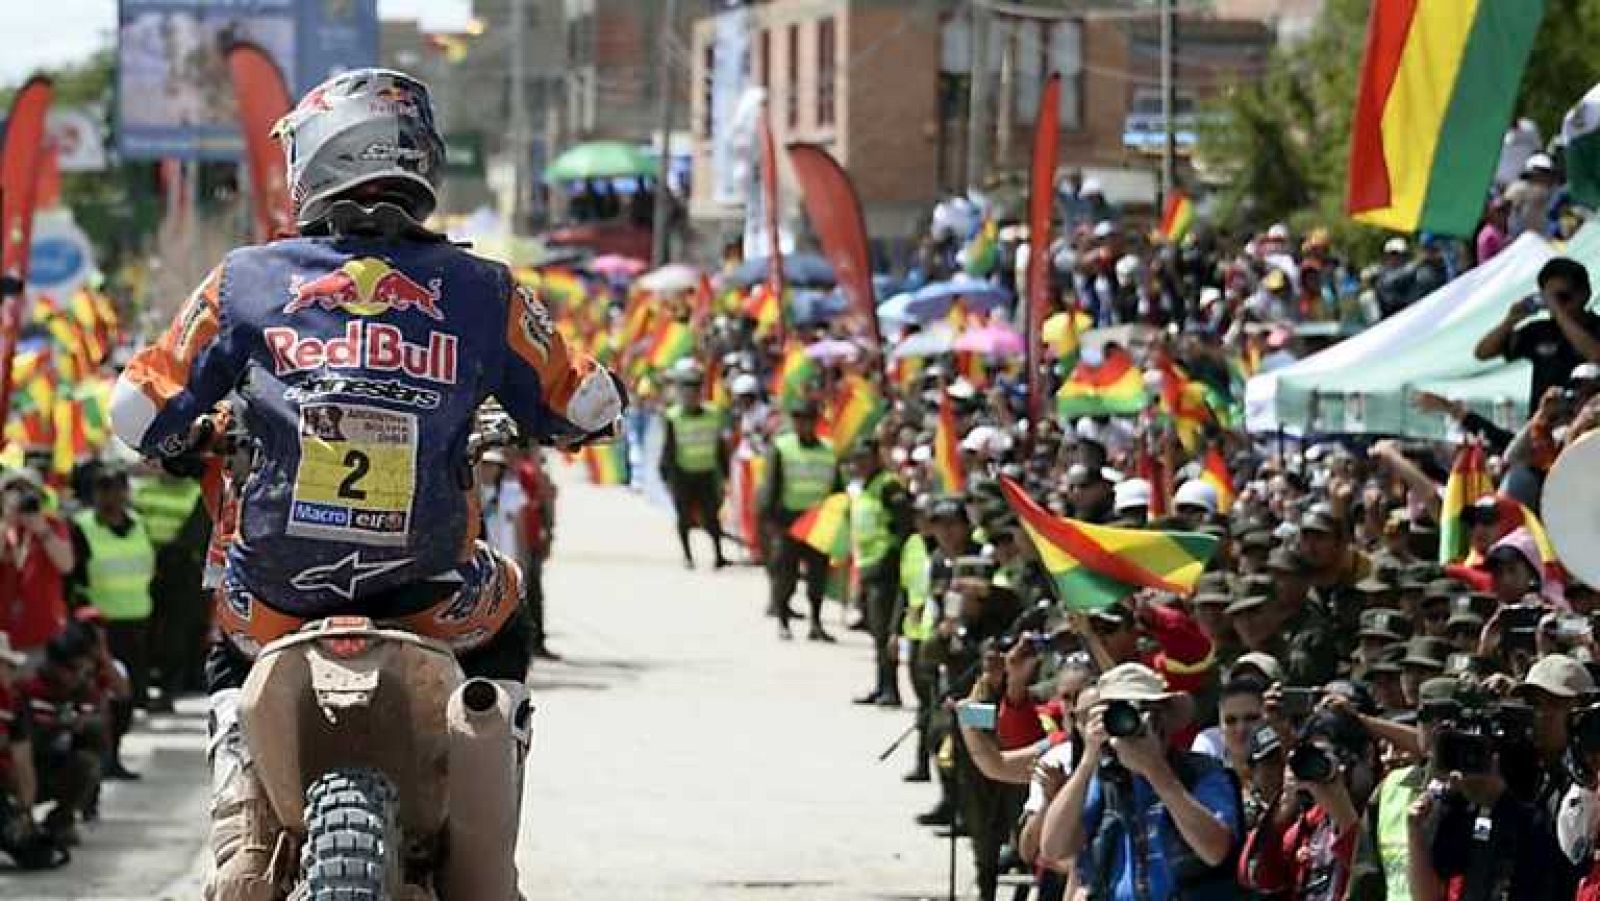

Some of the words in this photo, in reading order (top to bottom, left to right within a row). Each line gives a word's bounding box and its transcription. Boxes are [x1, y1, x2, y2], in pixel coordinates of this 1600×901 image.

[264, 319, 363, 376] Red
[366, 322, 457, 384] Bull
[338, 449, 370, 501] 2
[296, 504, 347, 524] Macro
